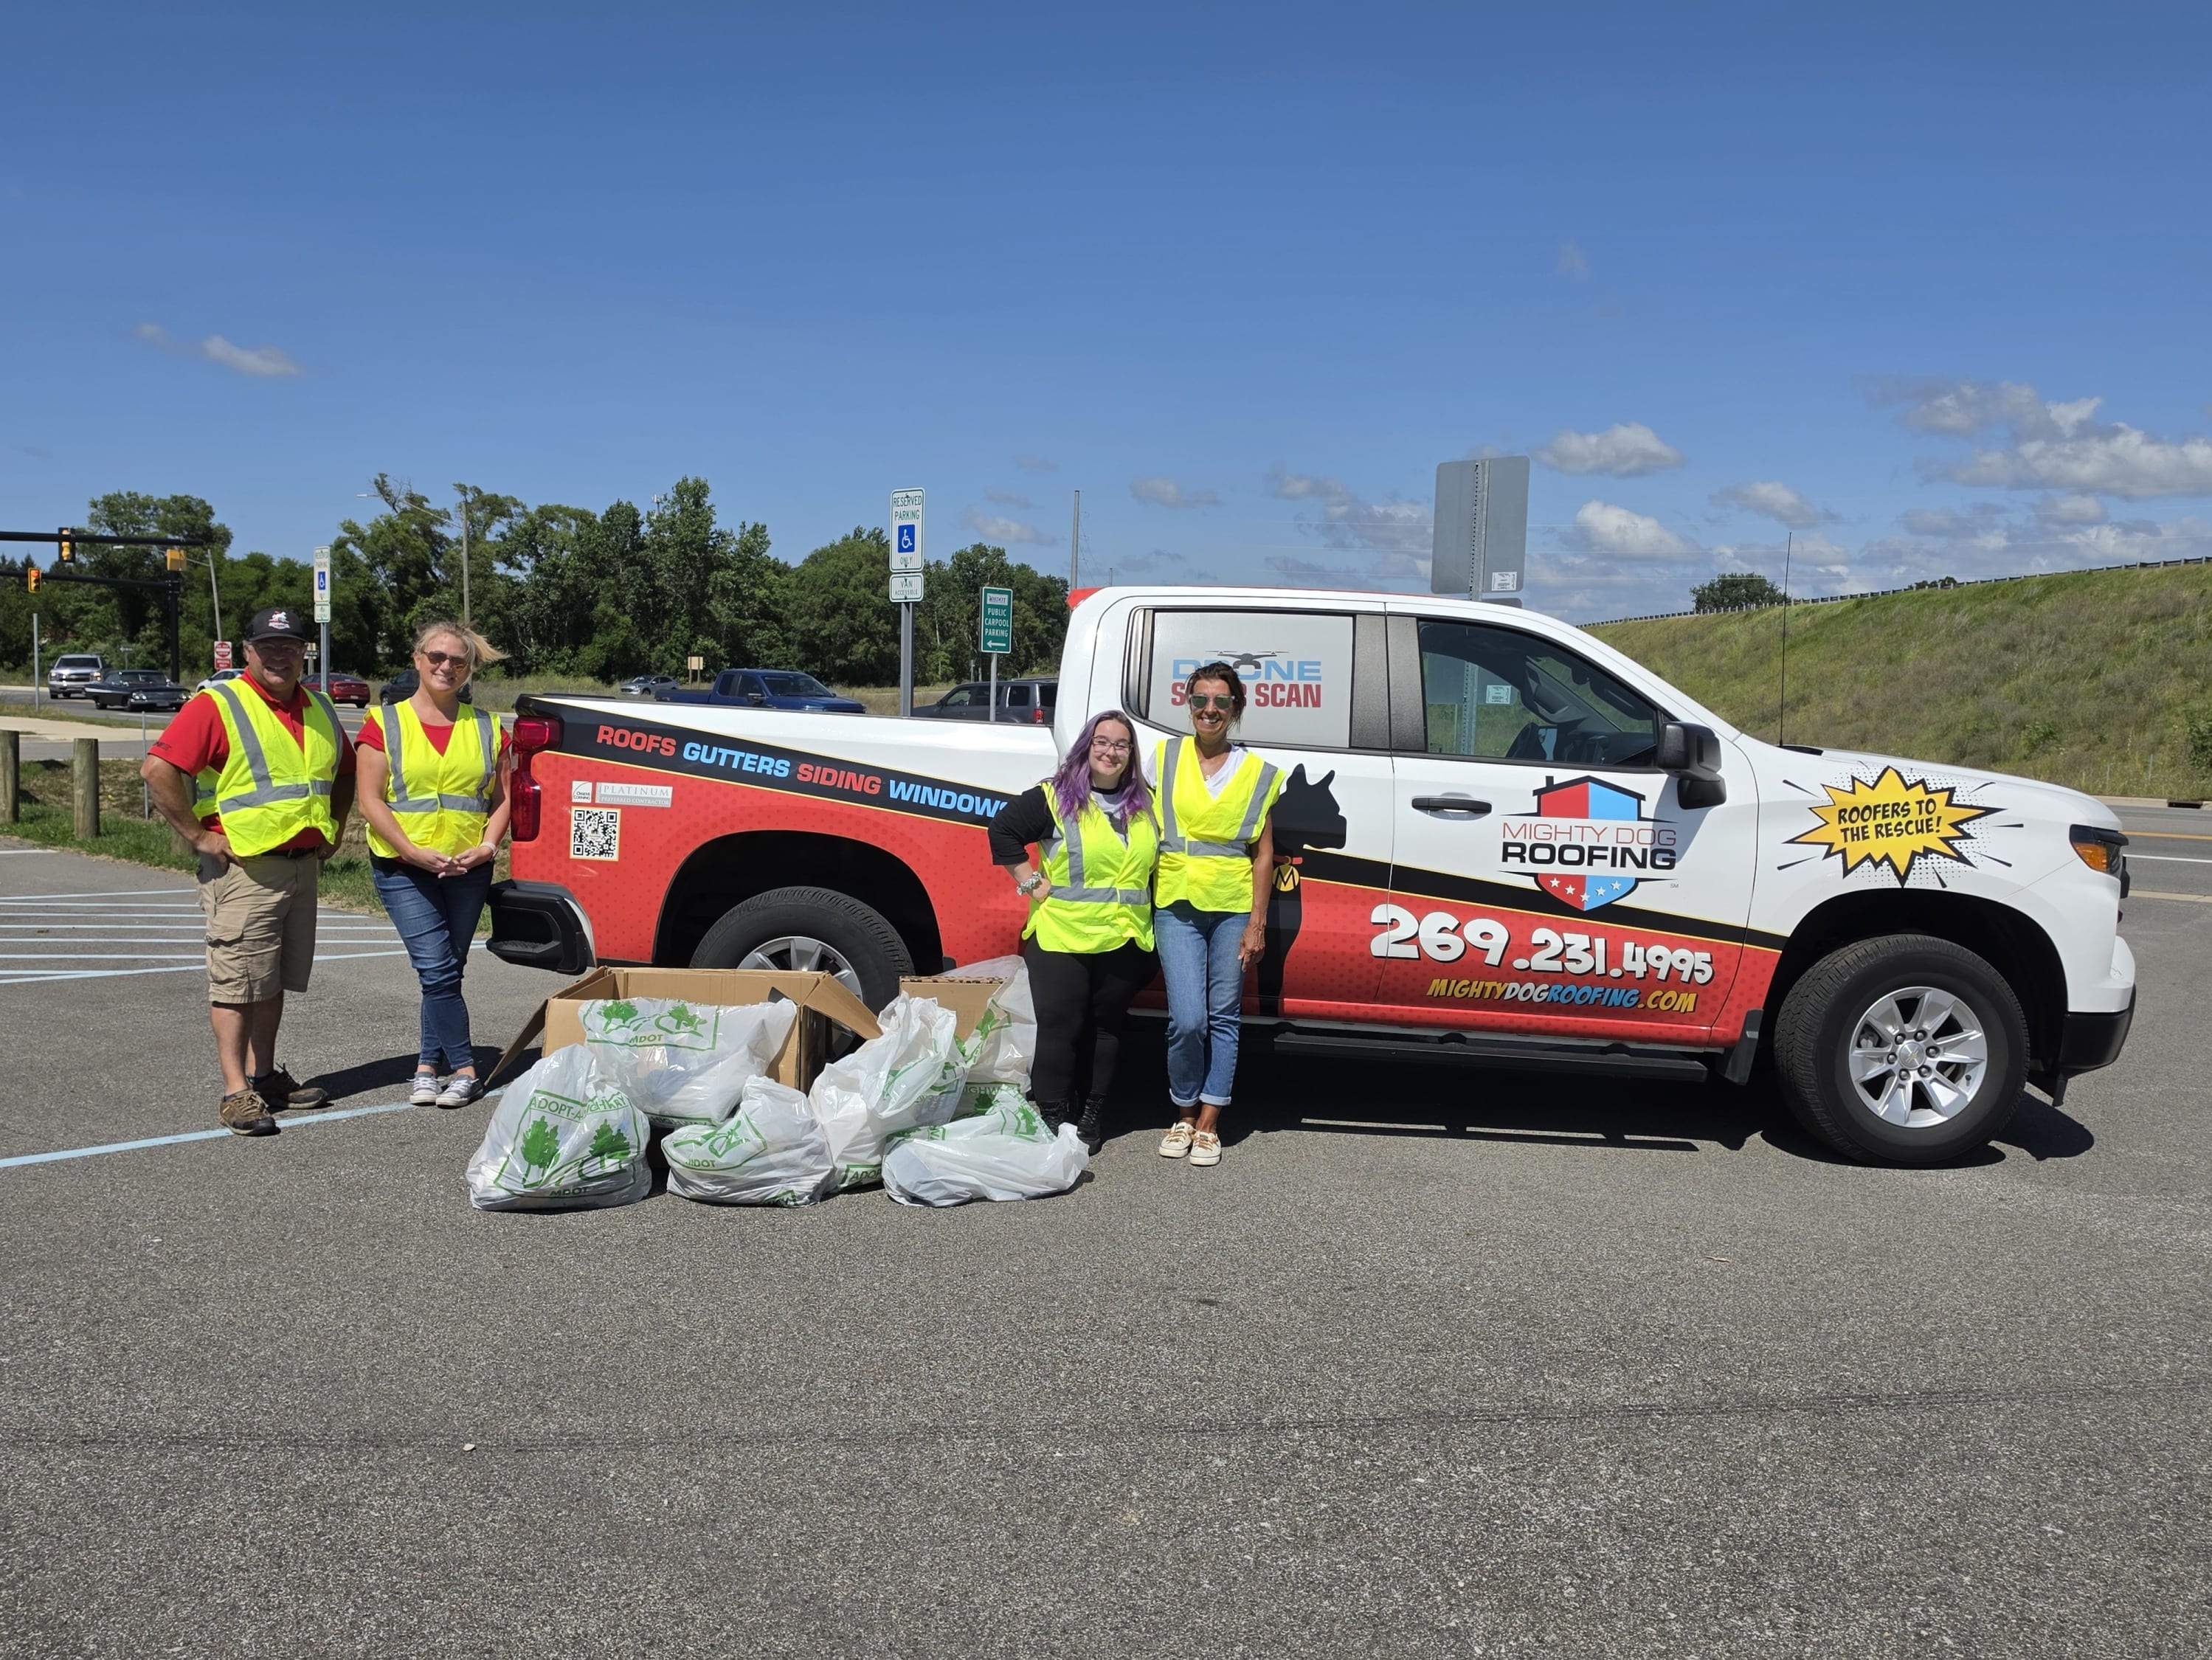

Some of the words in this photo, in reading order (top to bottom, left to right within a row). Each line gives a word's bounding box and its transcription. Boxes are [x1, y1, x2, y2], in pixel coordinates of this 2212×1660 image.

[893, 495, 922, 507] RESERVED
[894, 509, 920, 520] PARKING
[899, 556, 913, 566] ONLY
[900, 580, 913, 588] VAN
[987, 608, 1006, 616] PUBLIC
[984, 618, 1009, 627] CARPOOL
[985, 628, 1009, 637] PARKING
[1172, 659, 1322, 681] DONE
[1255, 683, 1321, 708] SCAN
[596, 725, 677, 756] ROOFS
[682, 741, 791, 778] GUTTERS
[796, 763, 882, 795] SIDING
[604, 785, 668, 797] PLATINUM
[1838, 801, 1910, 825] ROOFERS
[1915, 798, 1937, 815] TO
[1502, 823, 1608, 843] MIGHTY
[1616, 827, 1676, 846] DOG
[1840, 824, 1870, 843] THE
[1875, 815, 1943, 840] RESCUE!
[1501, 842, 1676, 870] ROOFING
[1370, 903, 1714, 985] 269.231.4995
[1427, 978, 1698, 1013] MIGHTYDOGROOFING.COM
[629, 1034, 663, 1043] MDOT
[550, 1186, 588, 1196] MDOT
